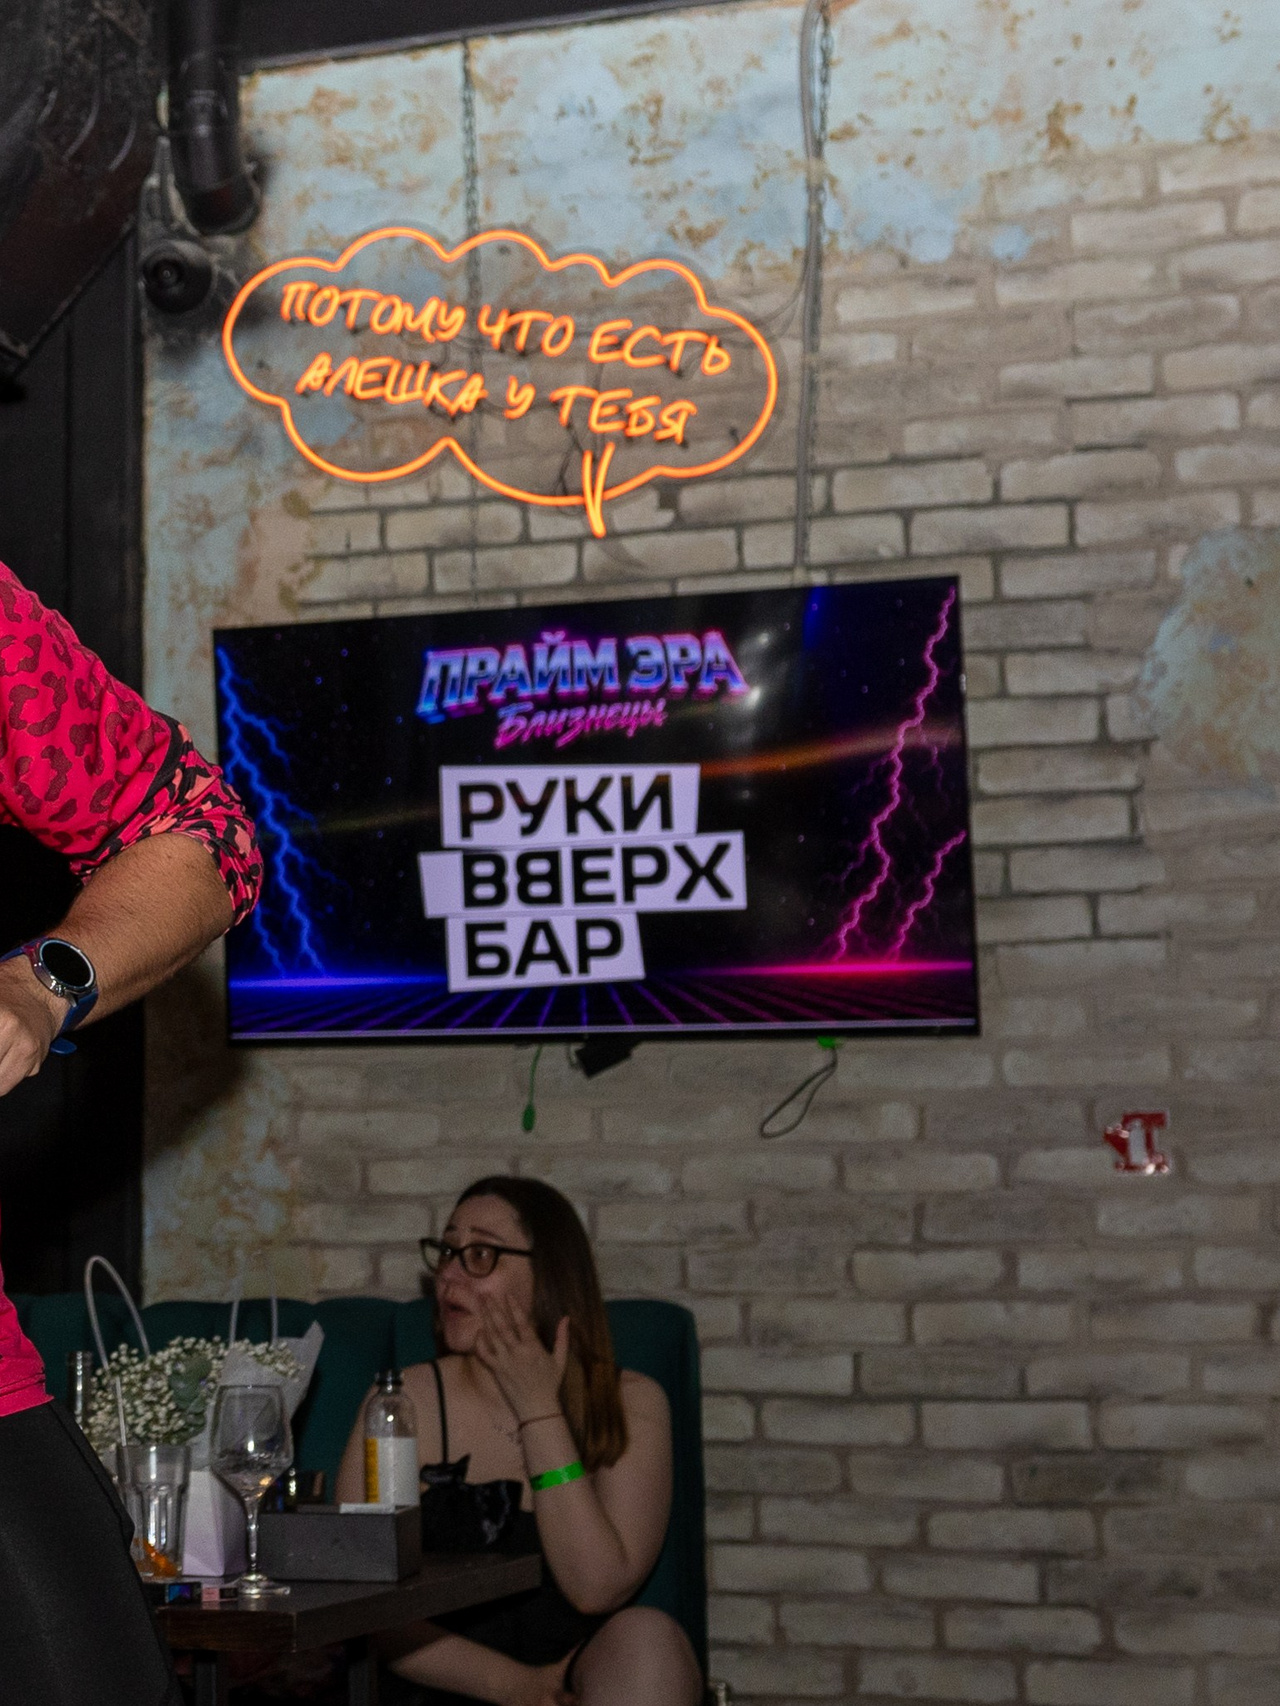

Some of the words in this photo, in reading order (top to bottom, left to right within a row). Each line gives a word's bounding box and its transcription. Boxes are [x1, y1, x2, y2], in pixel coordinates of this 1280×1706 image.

[281, 281, 466, 342] ПОТОМУ
[477, 304, 575, 356] ЧТО
[588, 319, 731, 374] ЕСТЬ
[295, 351, 487, 414] АЛЕШКА
[503, 376, 535, 419] У
[550, 385, 696, 443] ТЕБЯ
[416, 630, 621, 718] ПРАЙМ
[628, 631, 752, 692] ЭРА
[494, 699, 667, 749] Близнецы
[458, 775, 675, 839] РУКИ
[465, 920, 623, 977] БАР
